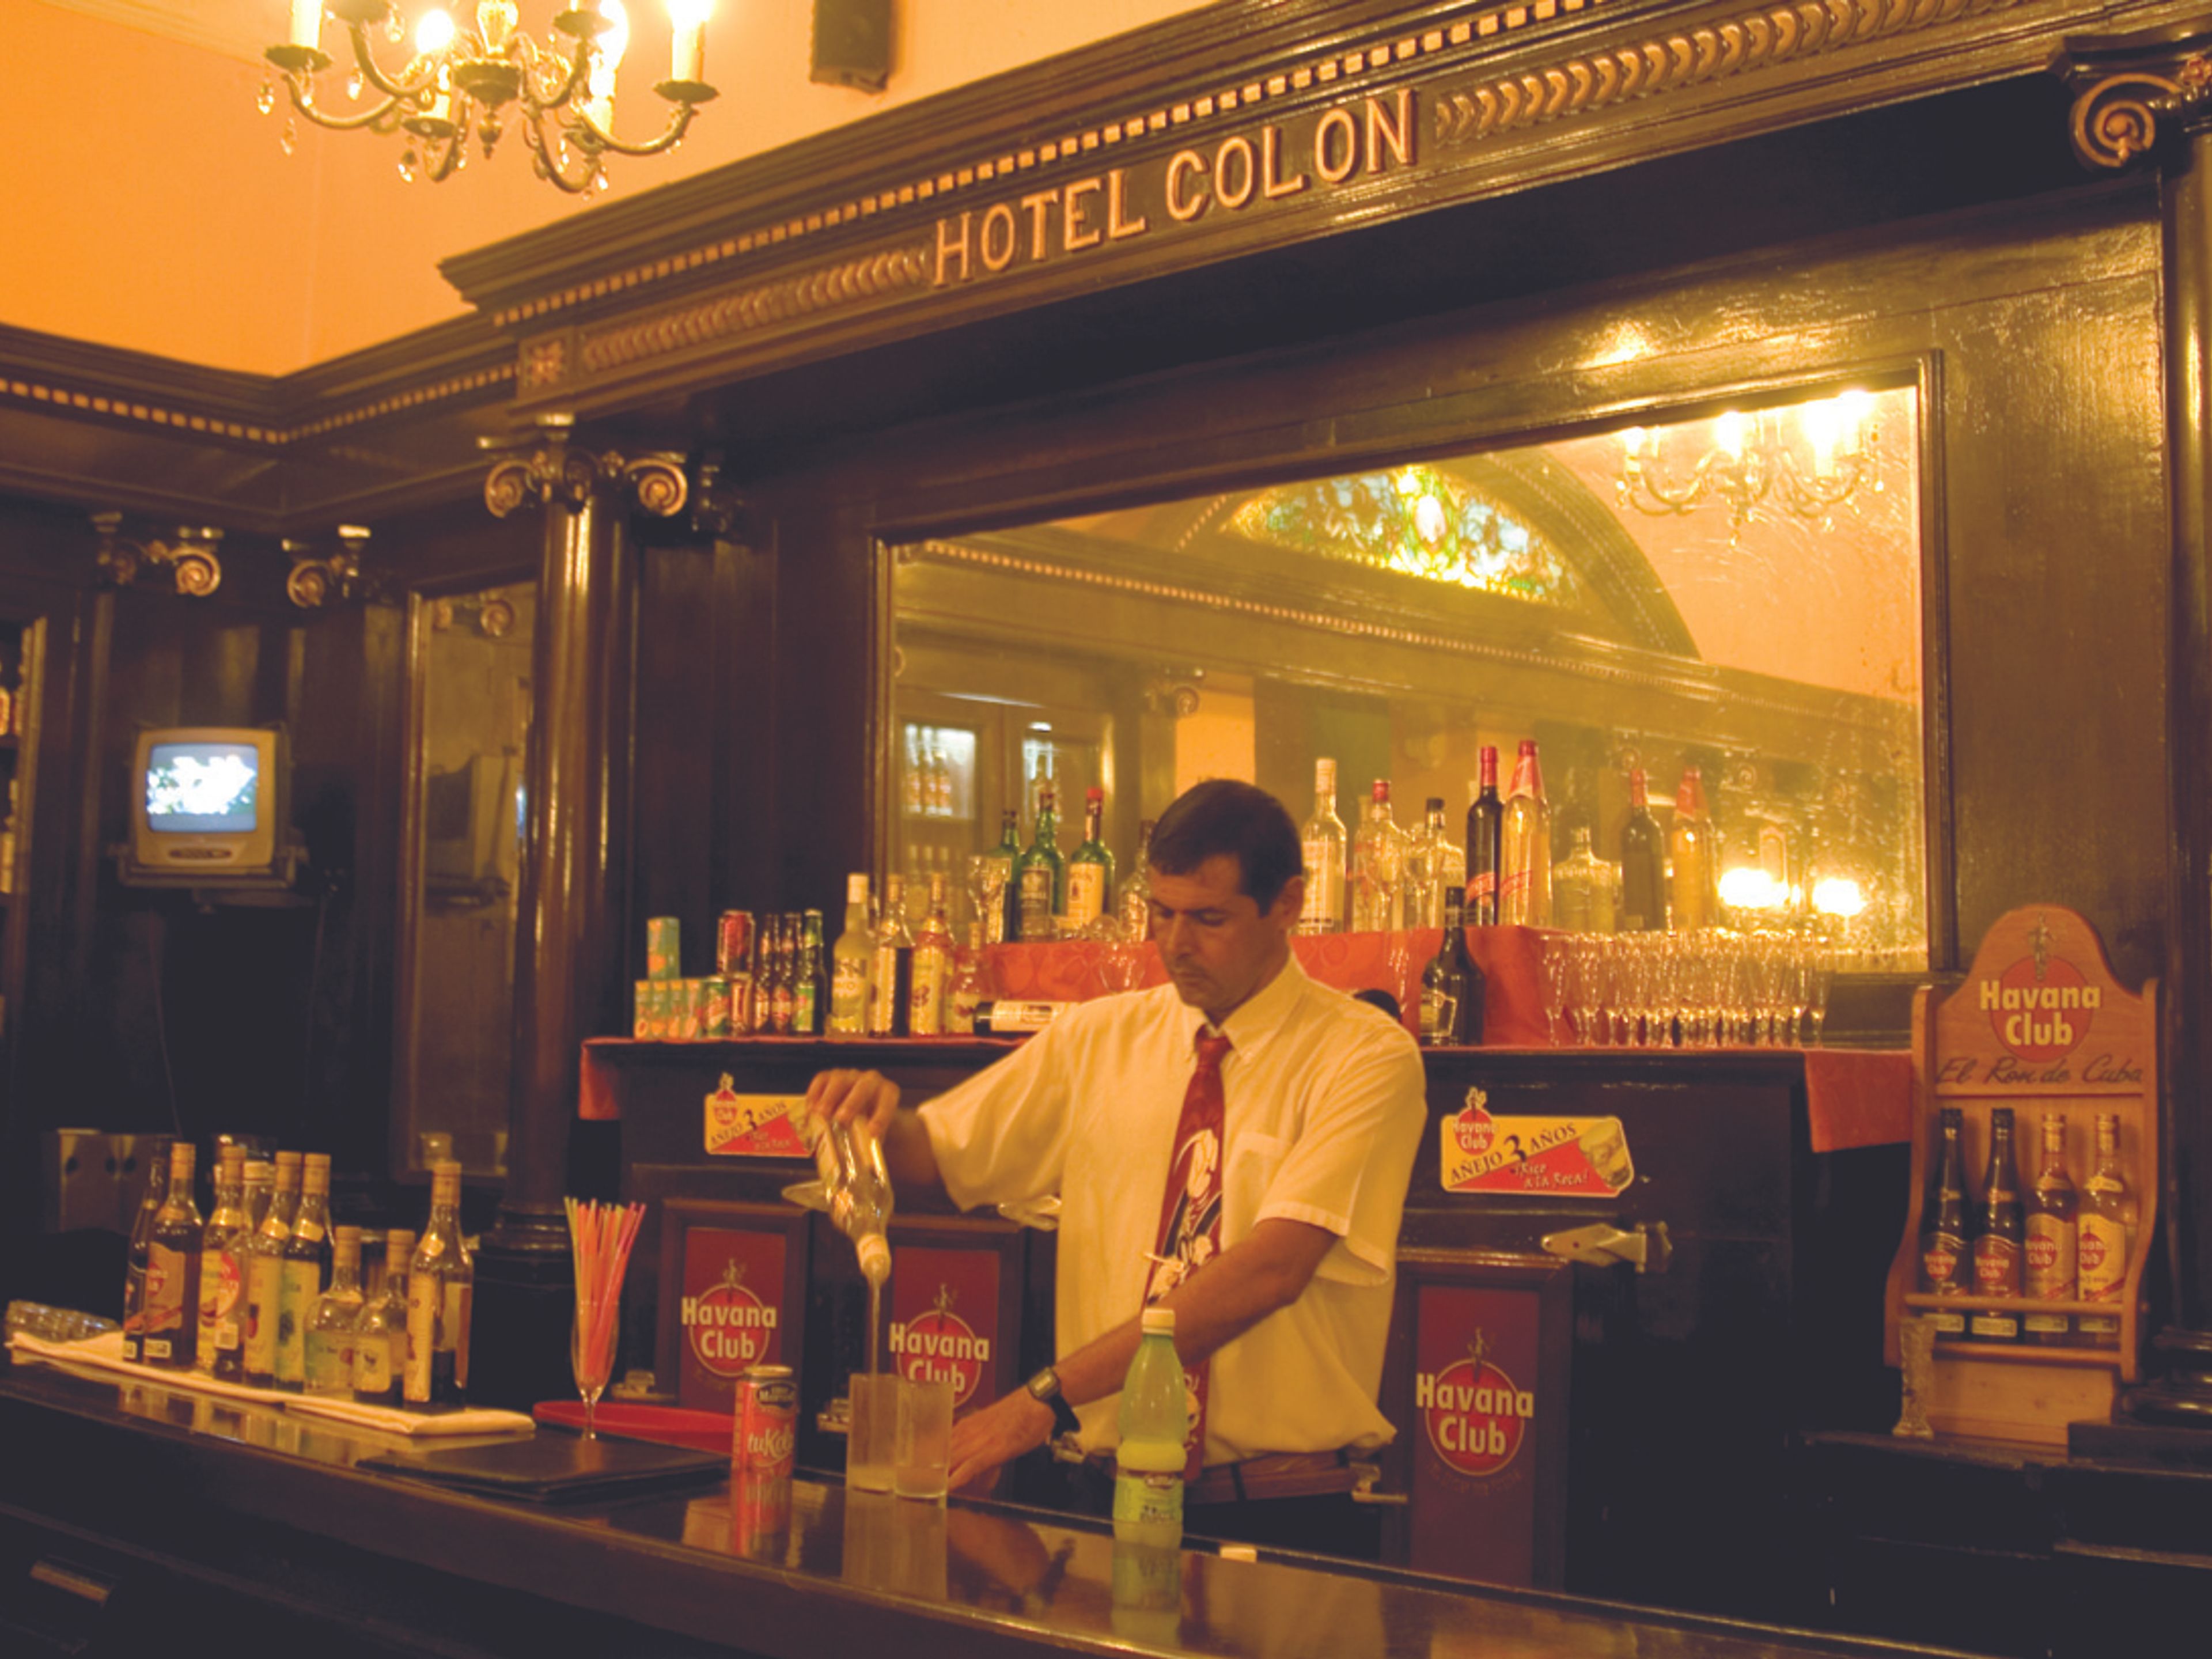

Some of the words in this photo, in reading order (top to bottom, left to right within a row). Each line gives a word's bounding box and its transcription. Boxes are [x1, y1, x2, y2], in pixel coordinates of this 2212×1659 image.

[934, 168, 1146, 286] HOTEL
[1165, 89, 1415, 221] COLON
[1980, 980, 2101, 1010] Havana
[2006, 1012, 2073, 1046] Club
[1936, 1056, 1978, 1085] El
[1983, 1056, 2036, 1085] Ron
[2040, 1059, 2071, 1084] de
[2081, 1054, 2143, 1084] Cuba
[1451, 1152, 1503, 1183] AÑEJO
[1503, 1134, 1527, 1174] 3
[1531, 1122, 1577, 1150] AÑOS
[1461, 1133, 1488, 1150] Club
[682, 1297, 777, 1328] Havana
[701, 1330, 754, 1359] Club
[889, 1323, 990, 1362] Havana
[909, 1358, 965, 1392] Club
[1416, 1373, 1534, 1419] Havana
[1439, 1415, 1506, 1455] Club
